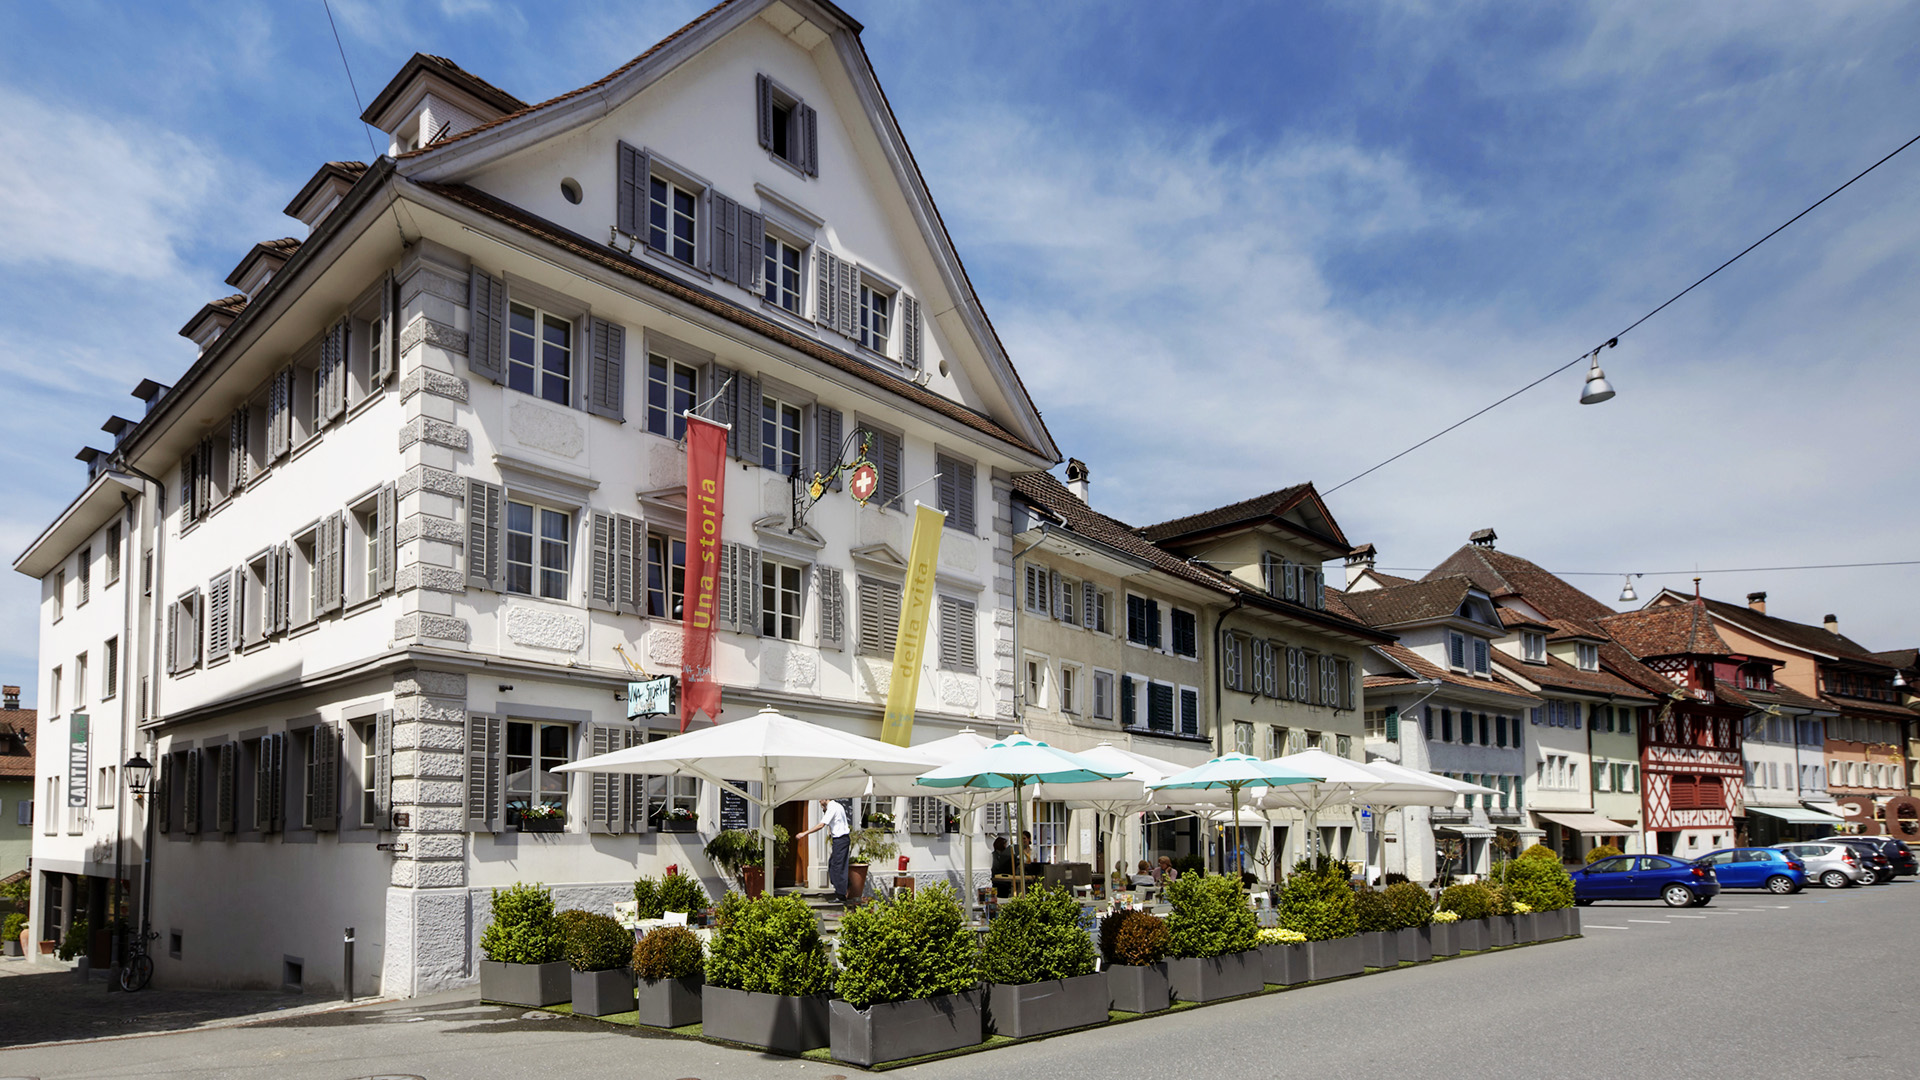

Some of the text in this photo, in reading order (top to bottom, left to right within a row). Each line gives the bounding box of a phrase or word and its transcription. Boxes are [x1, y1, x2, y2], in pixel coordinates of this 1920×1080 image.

[692, 478, 716, 629] Una storia
[900, 561, 927, 678] della vita
[71, 743, 86, 806] CANTINA
